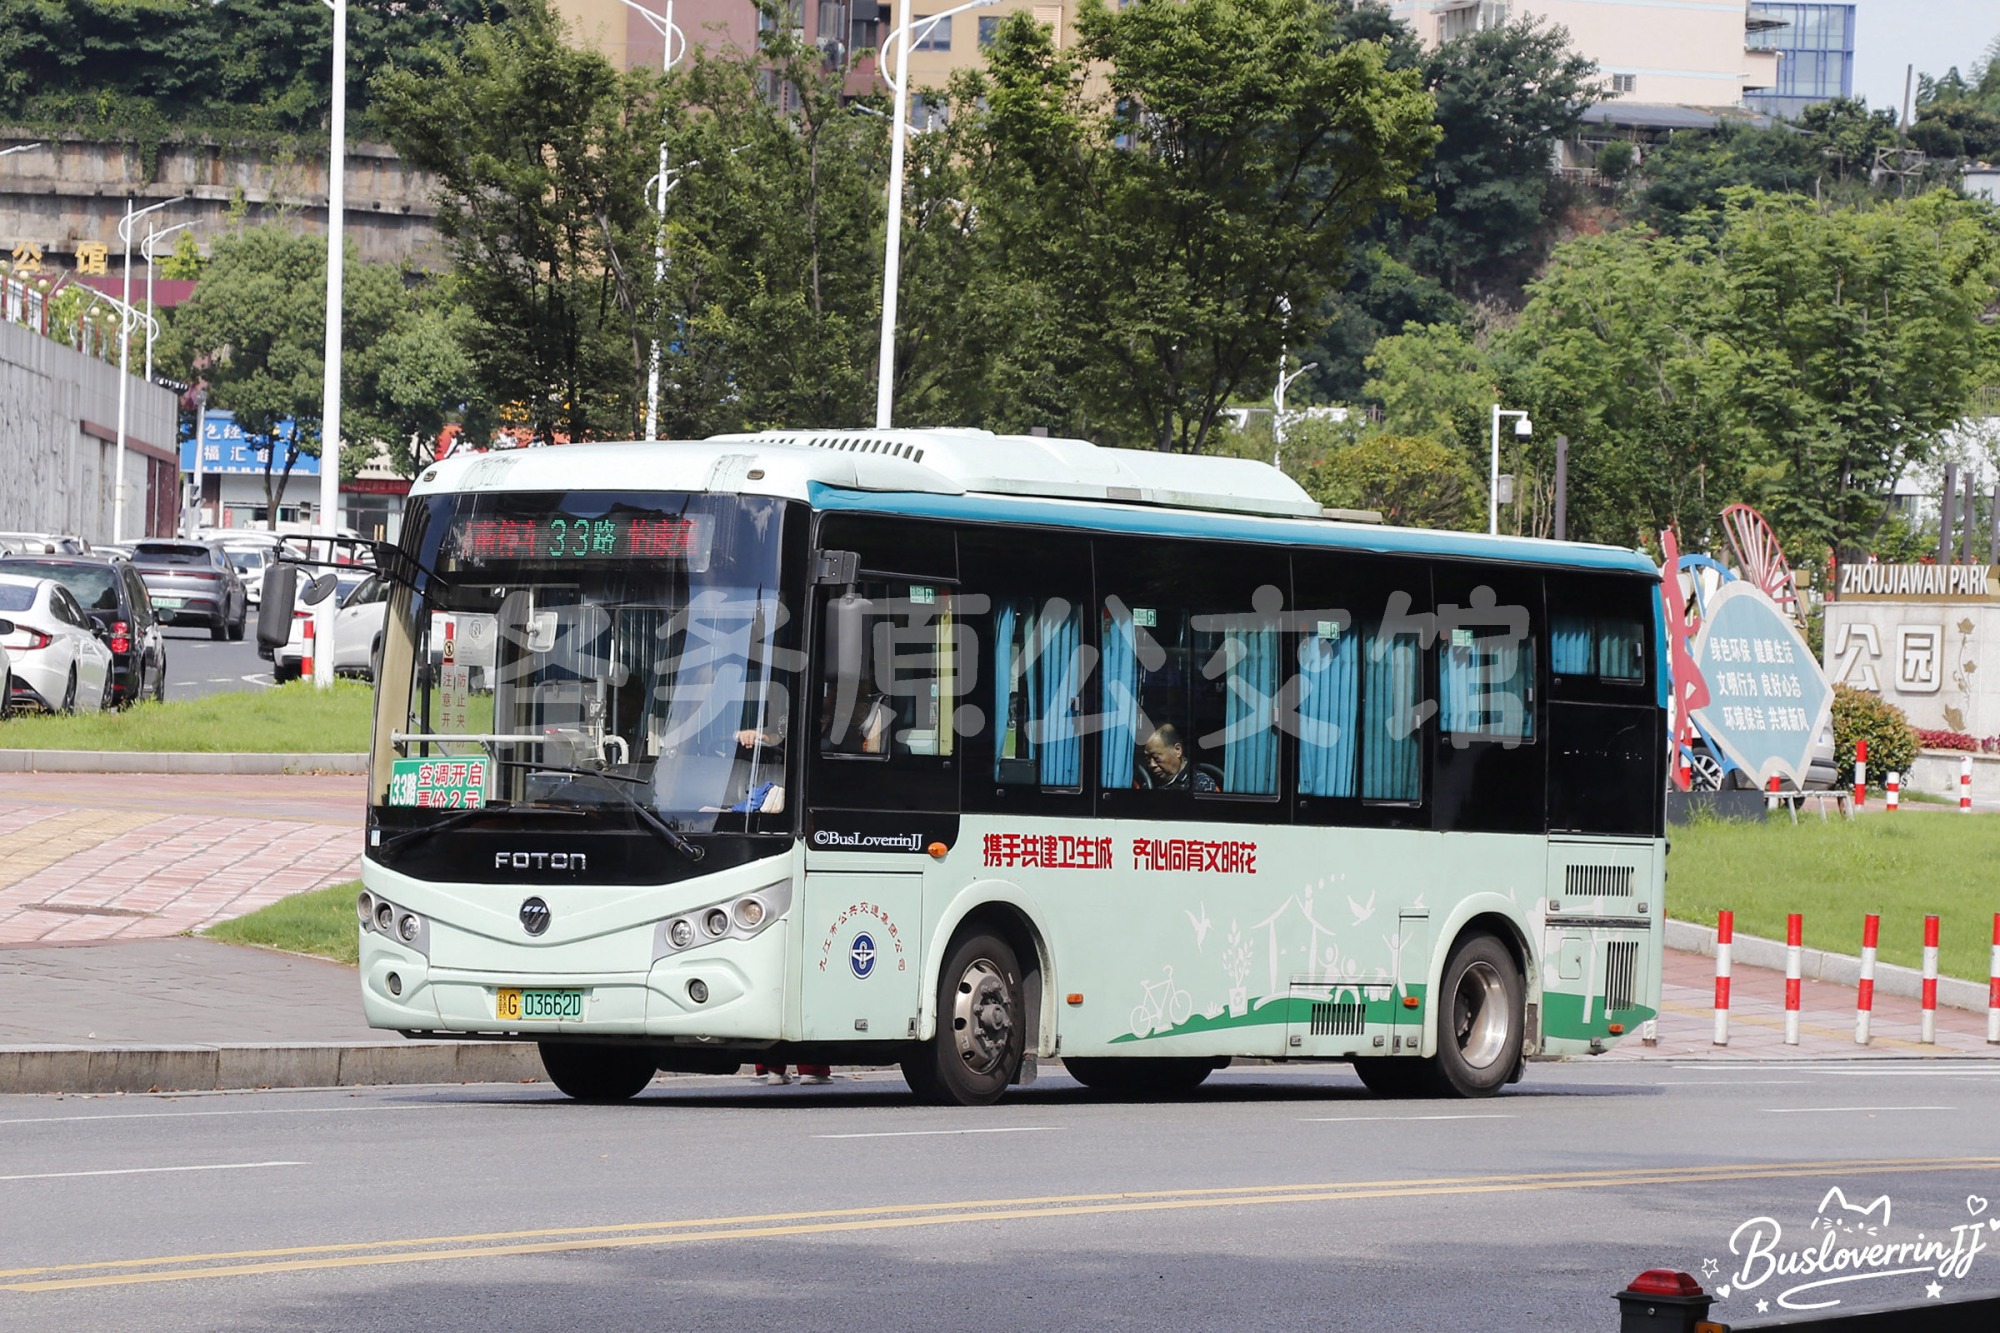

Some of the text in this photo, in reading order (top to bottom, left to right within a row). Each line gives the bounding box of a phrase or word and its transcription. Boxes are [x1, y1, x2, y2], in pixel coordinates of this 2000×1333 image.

[12, 242, 108, 275] 公馆
[551, 520, 616, 556] 33路
[1841, 564, 1991, 594] ZHOUJIAWAN PARK
[1710, 637, 1795, 664] 绿色环保 健康生活
[1834, 623, 1944, 692] 公园
[1717, 672, 1802, 698] 文明行为 良好心态
[1723, 706, 1766, 731] 环境保洁
[418, 761, 484, 787] 空调开启
[392, 772, 417, 806] 33路
[415, 789, 480, 809] 票价2元
[495, 852, 586, 870] FOTON
[983, 833, 1257, 874] 携手共建卫生城 齐心同育文明花
